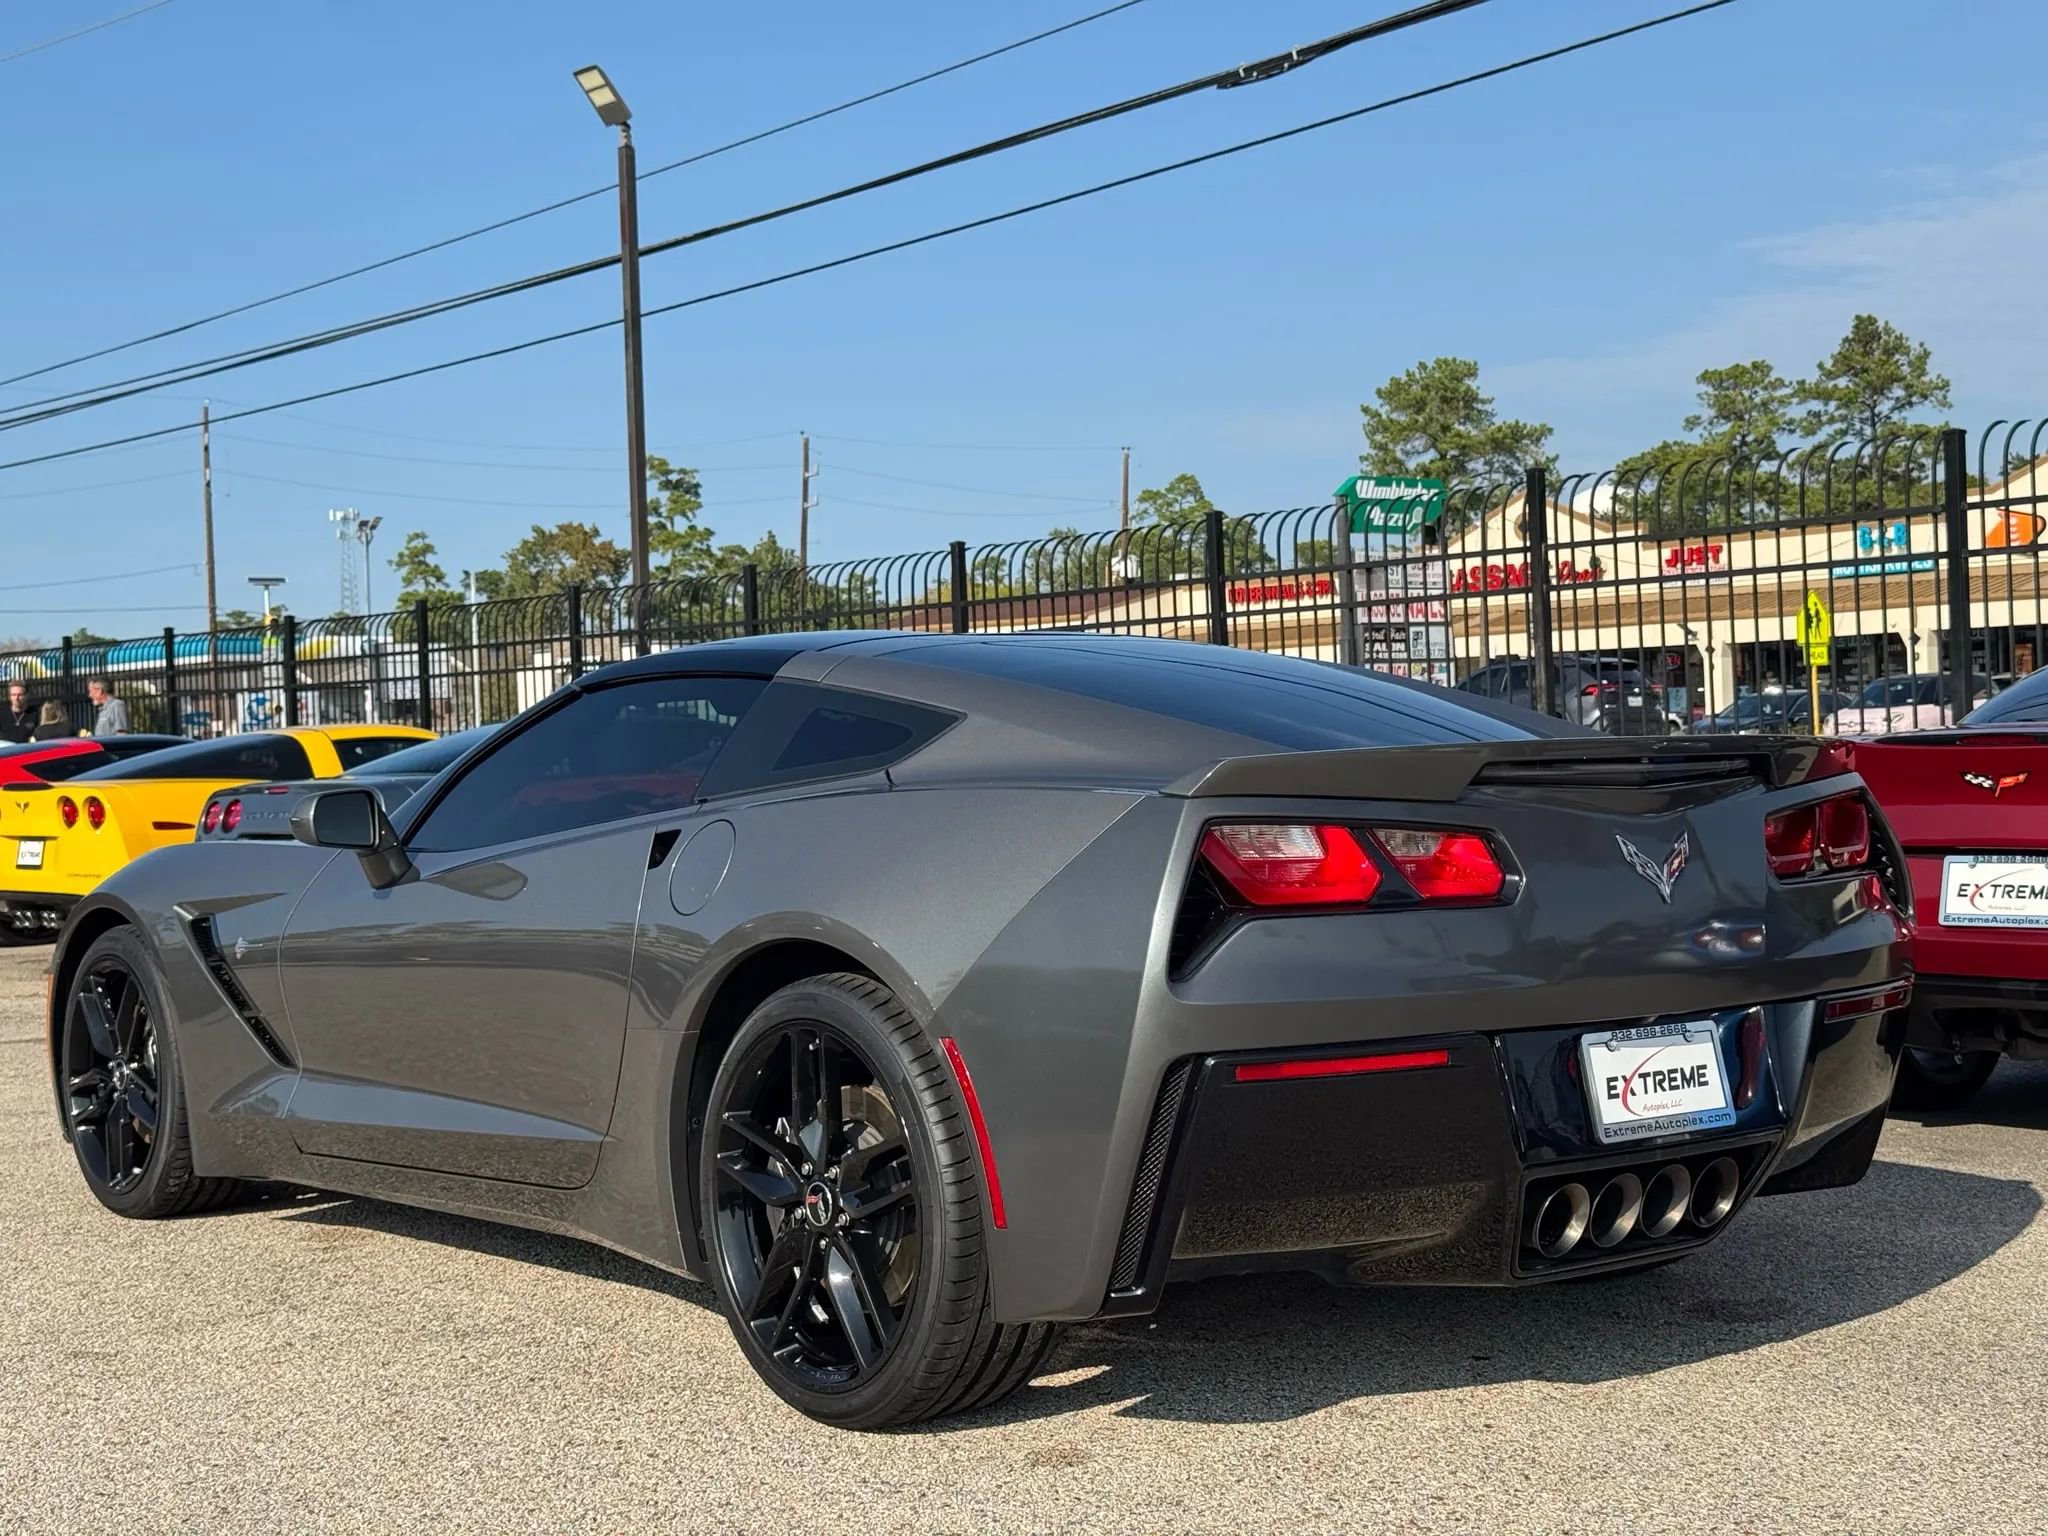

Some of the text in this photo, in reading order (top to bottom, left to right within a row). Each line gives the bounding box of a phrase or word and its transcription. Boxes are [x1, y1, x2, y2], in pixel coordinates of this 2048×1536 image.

[1665, 546, 1723, 567] JUST
[1407, 592, 1445, 619] NALS
[1957, 883, 2048, 900] EXTREM
[1606, 1064, 1709, 1100] EXTREME
[1604, 1112, 1732, 1139] ExtremeAutoplex.com
